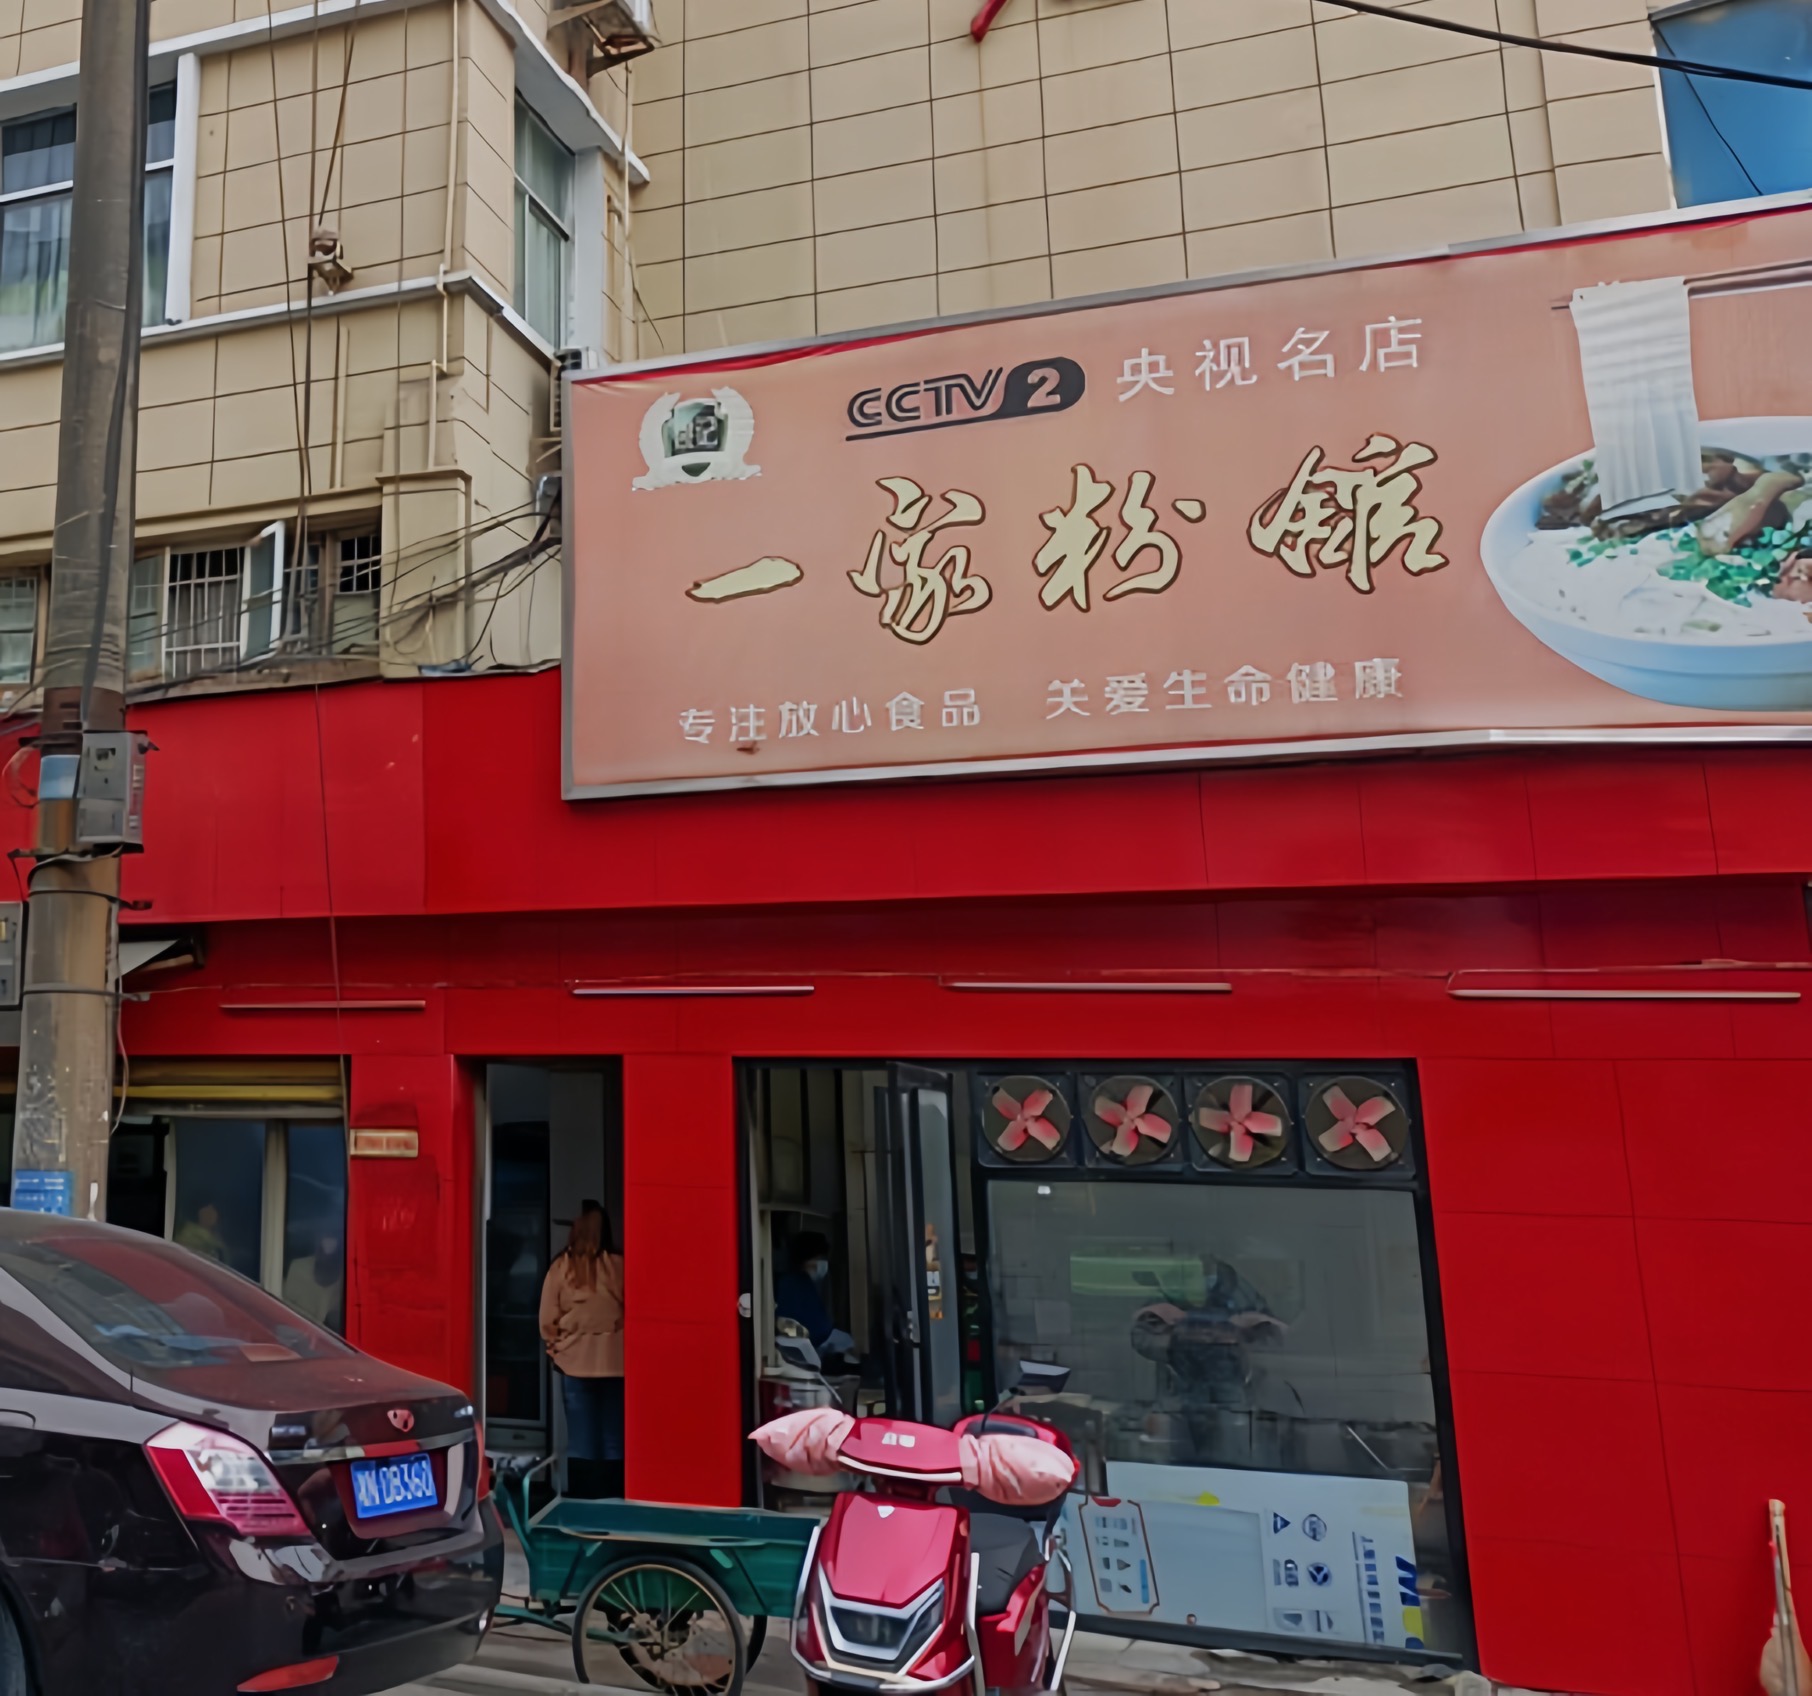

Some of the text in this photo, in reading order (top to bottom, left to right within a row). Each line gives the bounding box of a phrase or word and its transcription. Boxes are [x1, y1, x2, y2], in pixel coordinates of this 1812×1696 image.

[1116, 315, 1423, 402] 央视名店
[678, 658, 1403, 744] 专注放心食品 关爱生命健康
